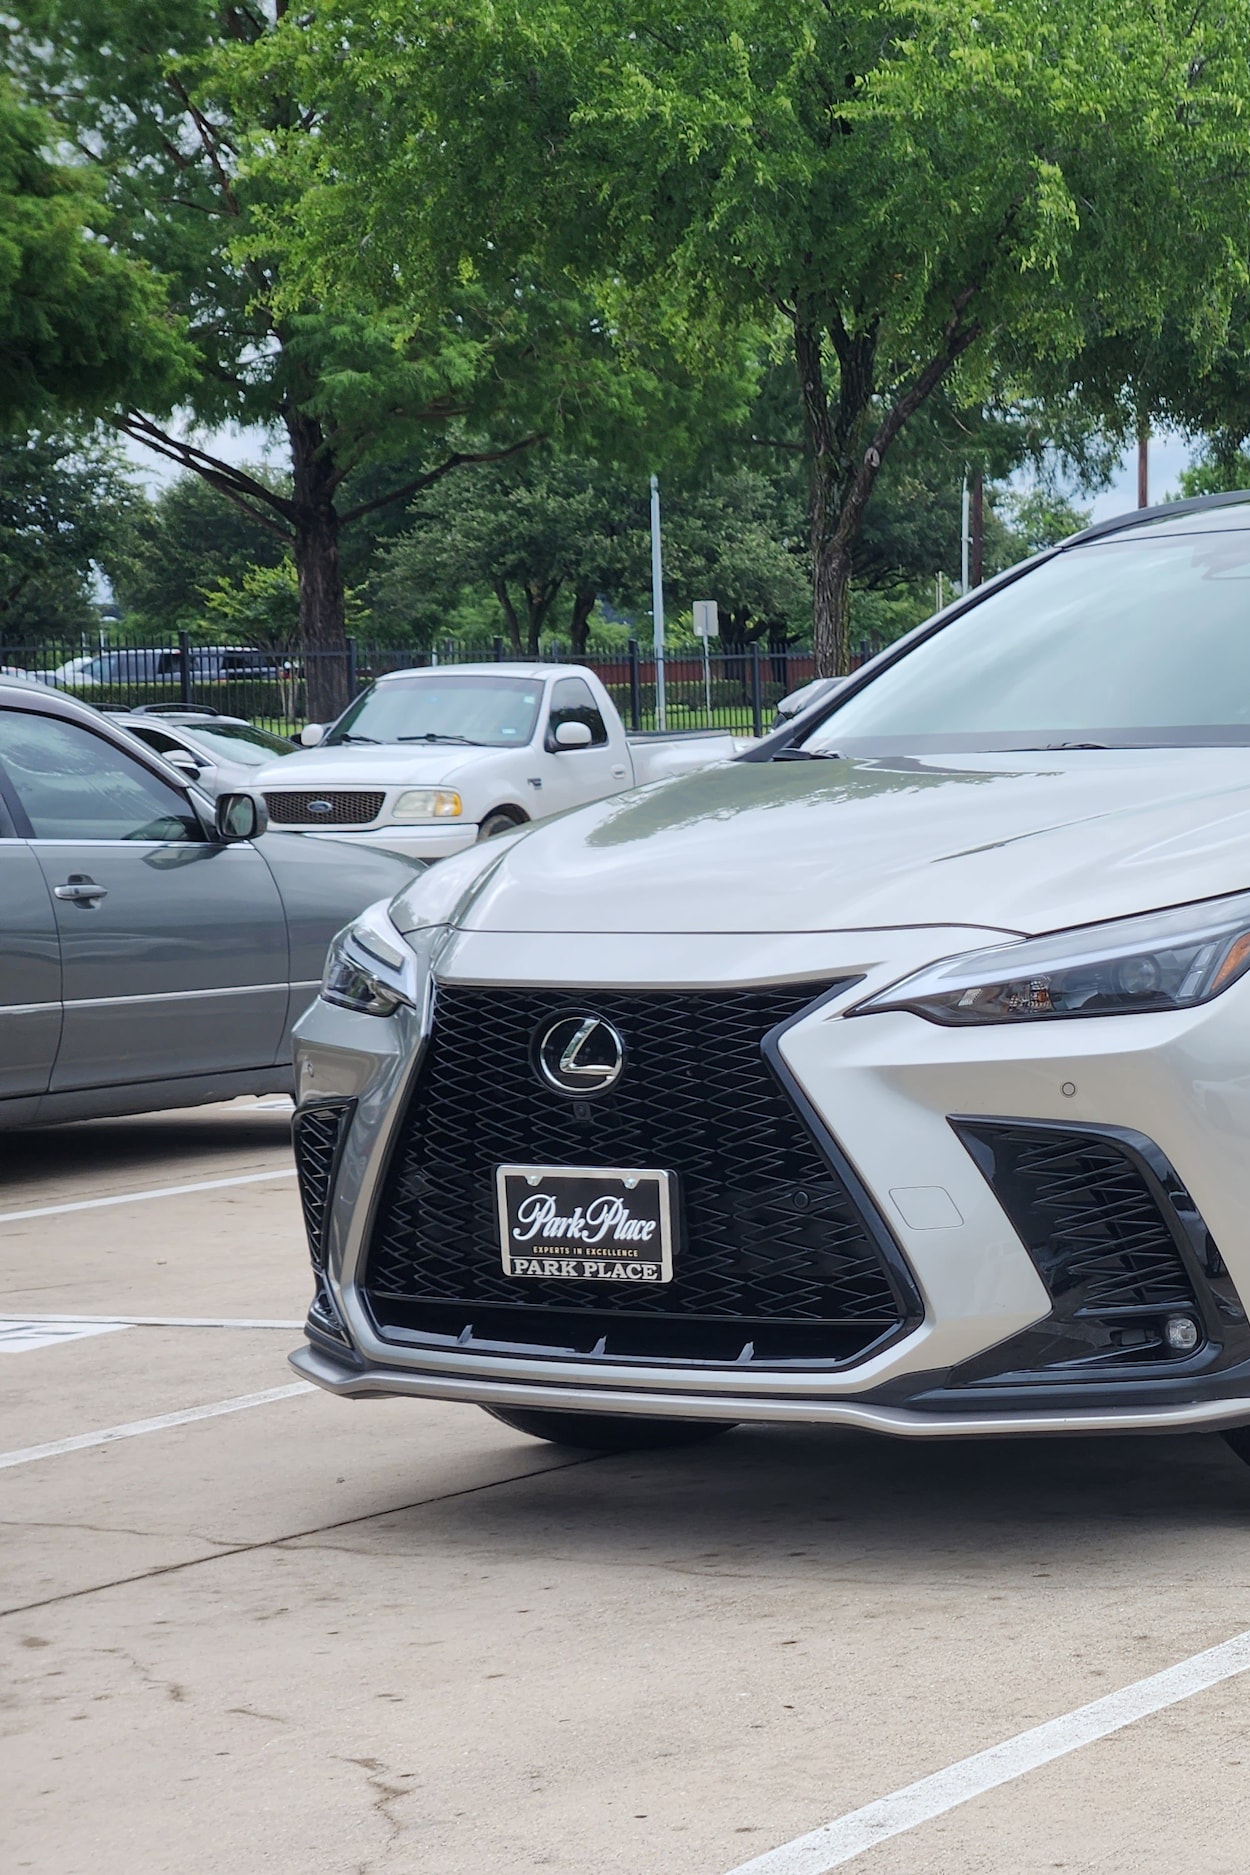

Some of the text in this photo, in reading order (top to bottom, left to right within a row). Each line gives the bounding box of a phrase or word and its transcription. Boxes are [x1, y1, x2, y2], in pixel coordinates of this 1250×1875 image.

[512, 1193, 657, 1243] Park Place
[533, 1245, 639, 1257] EXPERTS IN EXCELLENCE
[513, 1259, 659, 1280] PARK PLACE
